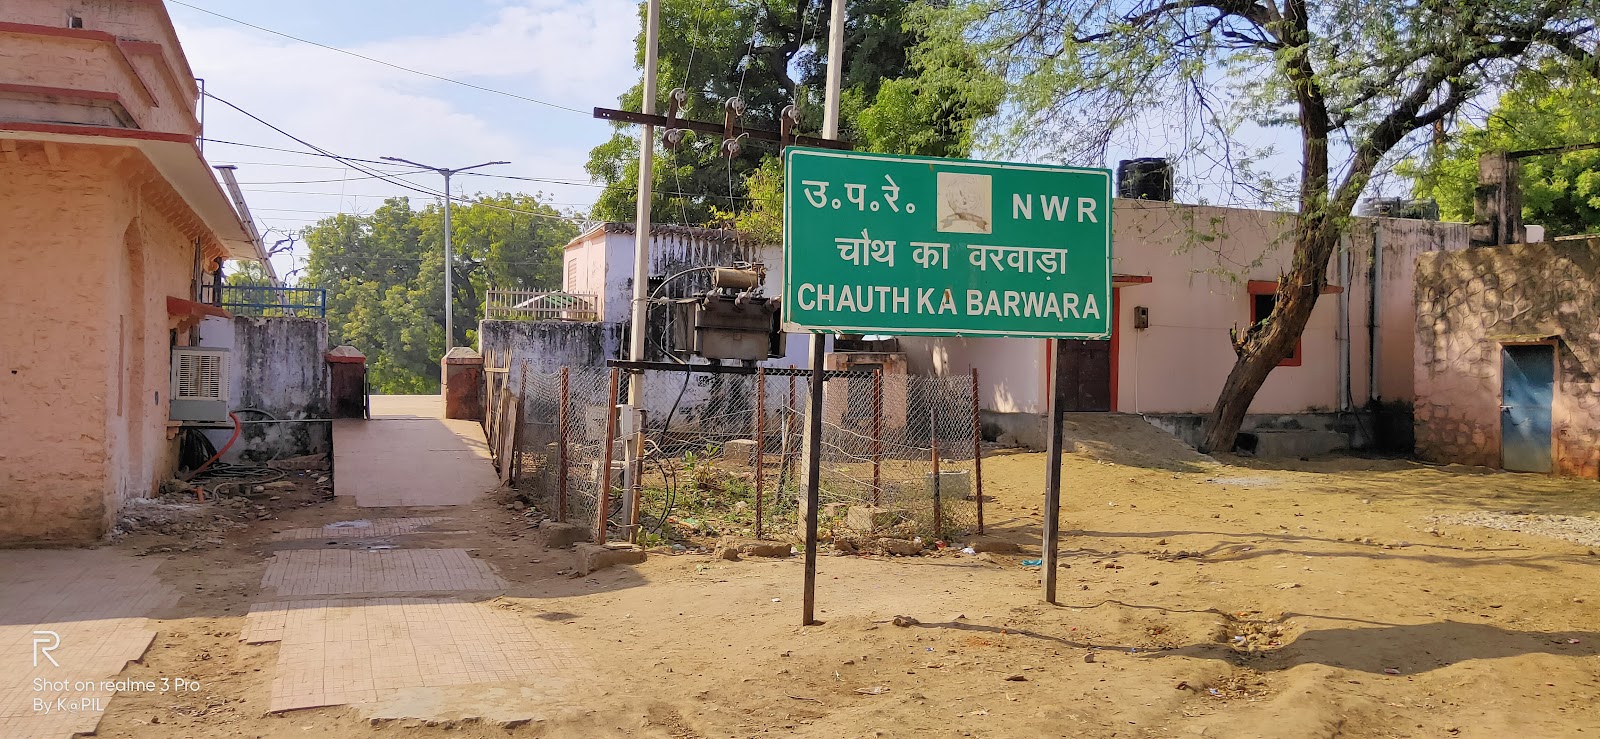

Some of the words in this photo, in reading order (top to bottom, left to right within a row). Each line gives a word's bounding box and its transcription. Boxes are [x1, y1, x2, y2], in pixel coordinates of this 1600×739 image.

[835, 228, 896, 267] चौथ
[910, 241, 950, 270] का
[966, 244, 1068, 281] वरवाड़ा
[797, 282, 909, 314] CHAUTH
[917, 287, 958, 316] KA
[966, 289, 1100, 320] BARWARA
